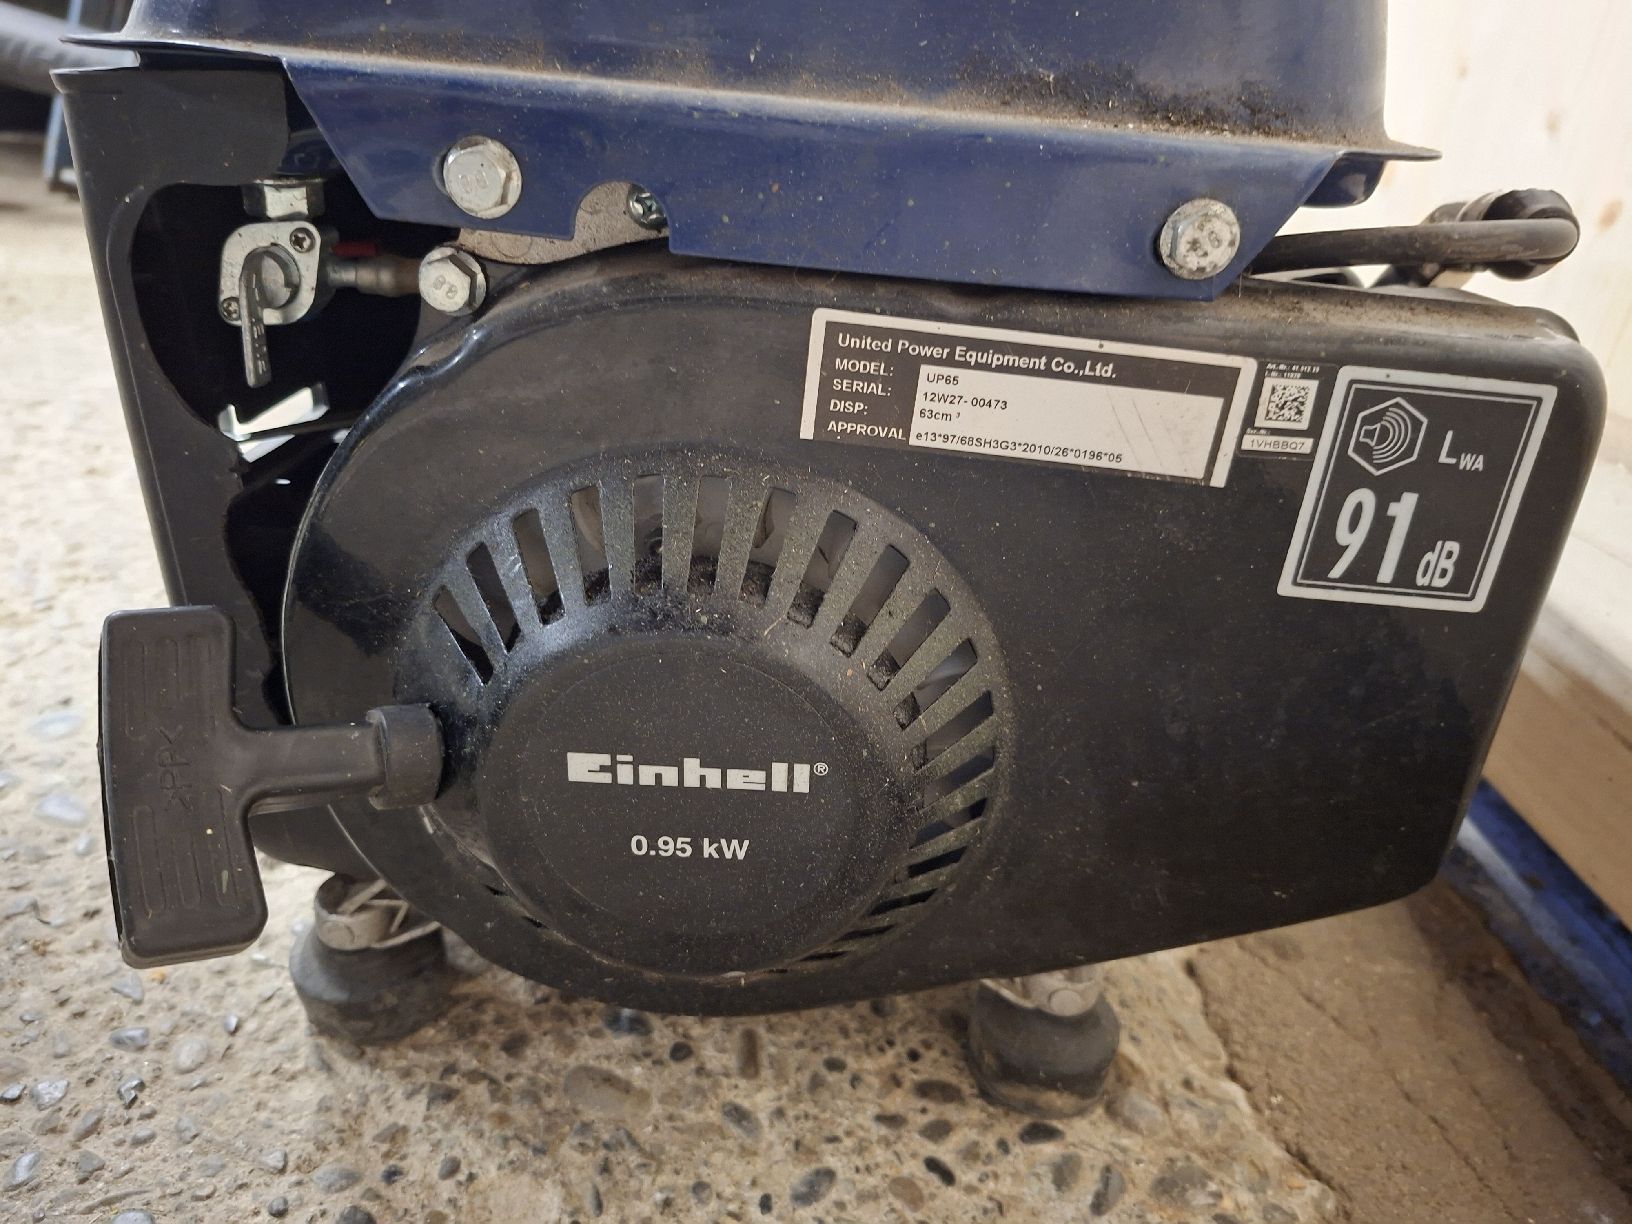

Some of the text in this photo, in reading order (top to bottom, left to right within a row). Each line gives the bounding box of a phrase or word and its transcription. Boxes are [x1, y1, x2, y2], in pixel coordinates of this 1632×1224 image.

[838, 332, 1117, 379] United Power Equipment Co.,Ltd.
[835, 358, 959, 386] MODEL: UP65
[829, 399, 868, 415] DISP:
[832, 378, 892, 396] SERIAL:
[971, 396, 1008, 410] 00473
[827, 420, 907, 441] APPROVAL
[1327, 487, 1460, 588] 91 dB
[630, 834, 750, 860] 0.95 kW
